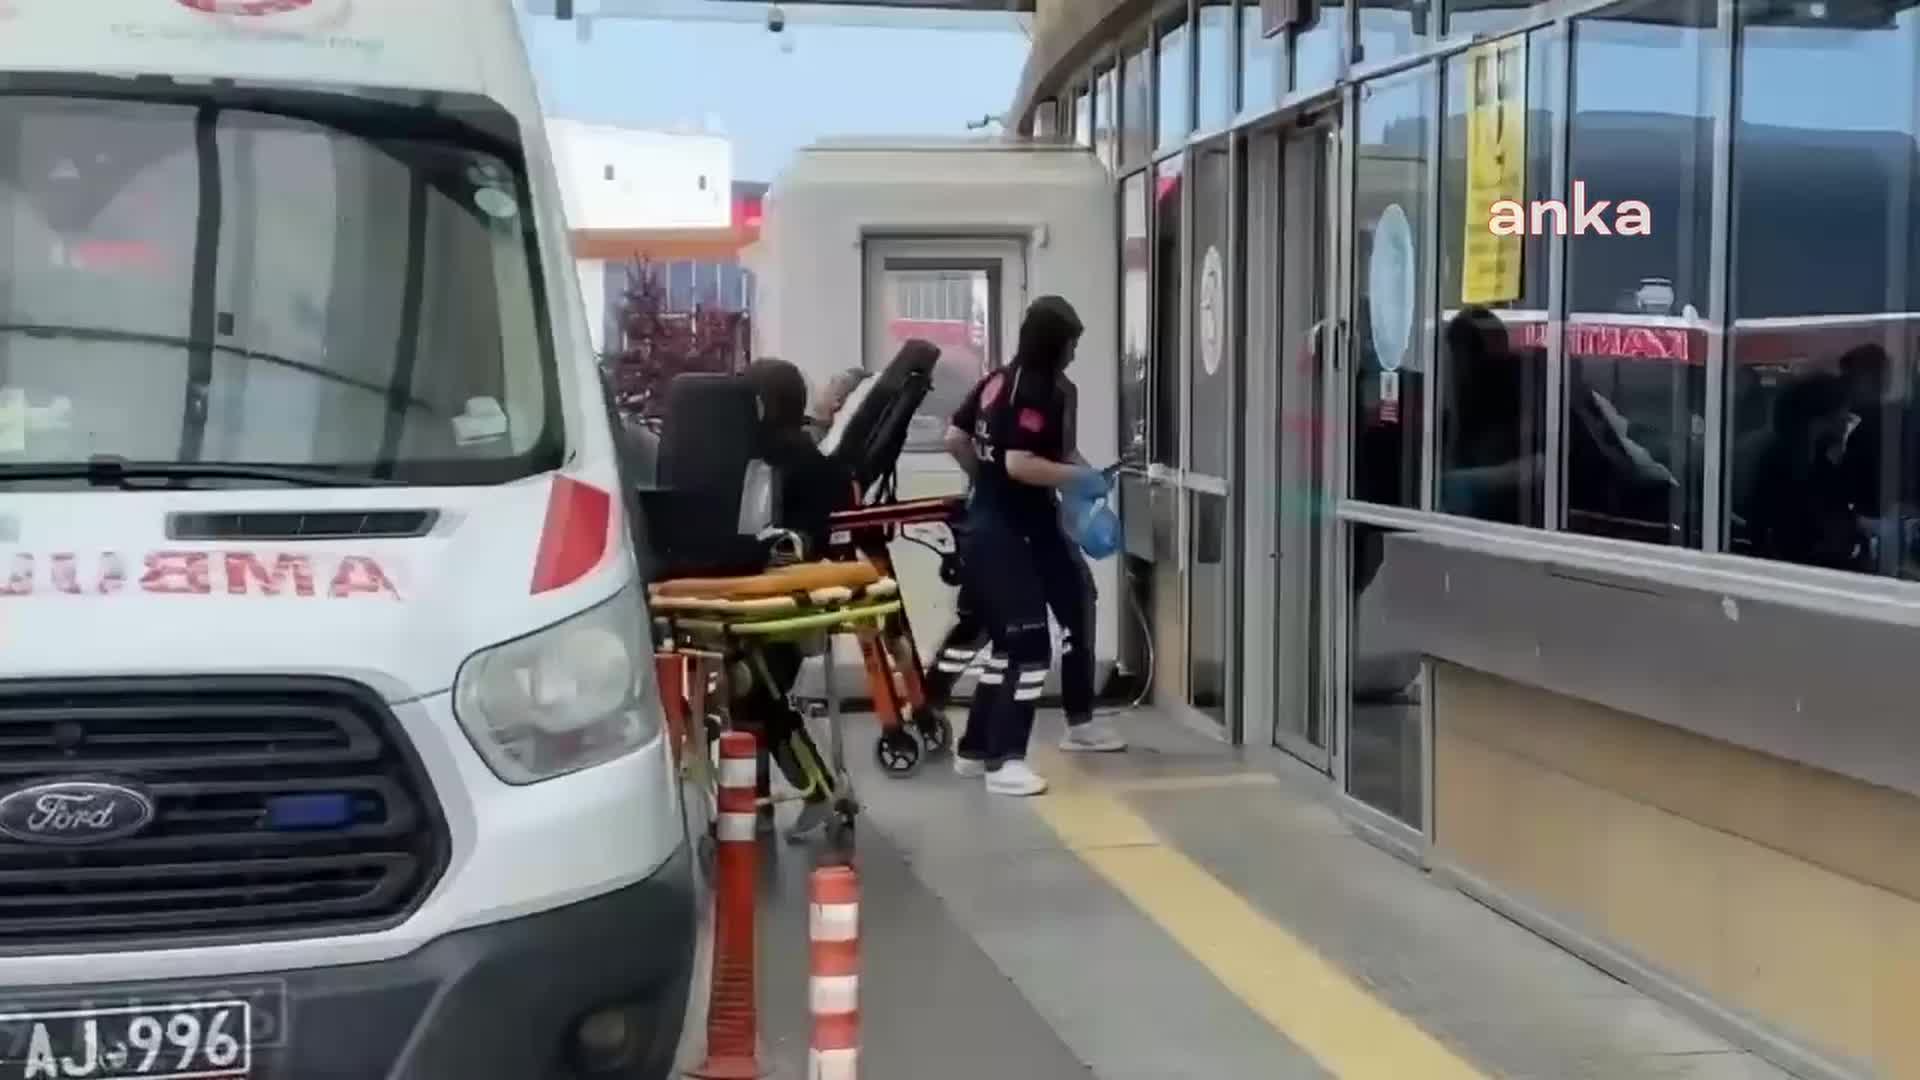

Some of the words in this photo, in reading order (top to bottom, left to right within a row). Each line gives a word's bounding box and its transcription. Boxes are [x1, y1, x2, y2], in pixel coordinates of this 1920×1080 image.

[27, 792, 113, 830] Ford
[24, 1019, 98, 1079] AJ
[129, 1010, 239, 1073] 996
